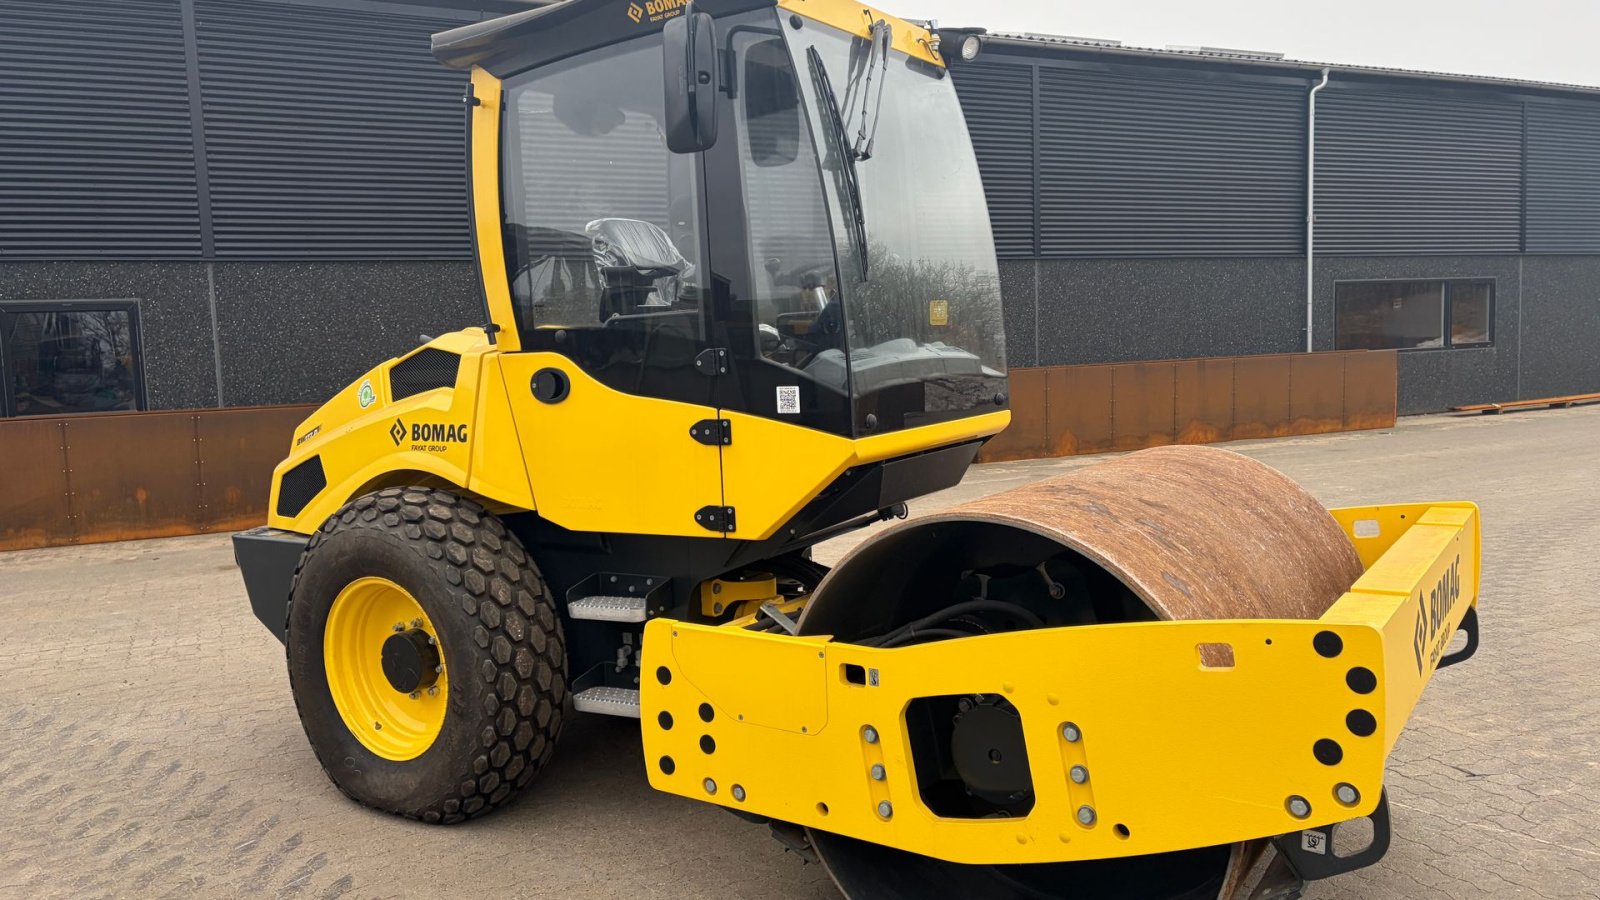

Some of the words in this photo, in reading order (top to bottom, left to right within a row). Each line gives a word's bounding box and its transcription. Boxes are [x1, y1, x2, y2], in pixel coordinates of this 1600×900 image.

[645, 0, 688, 15] BOMA
[412, 423, 467, 442] BOMAG
[1430, 553, 1459, 641] BOMAG
